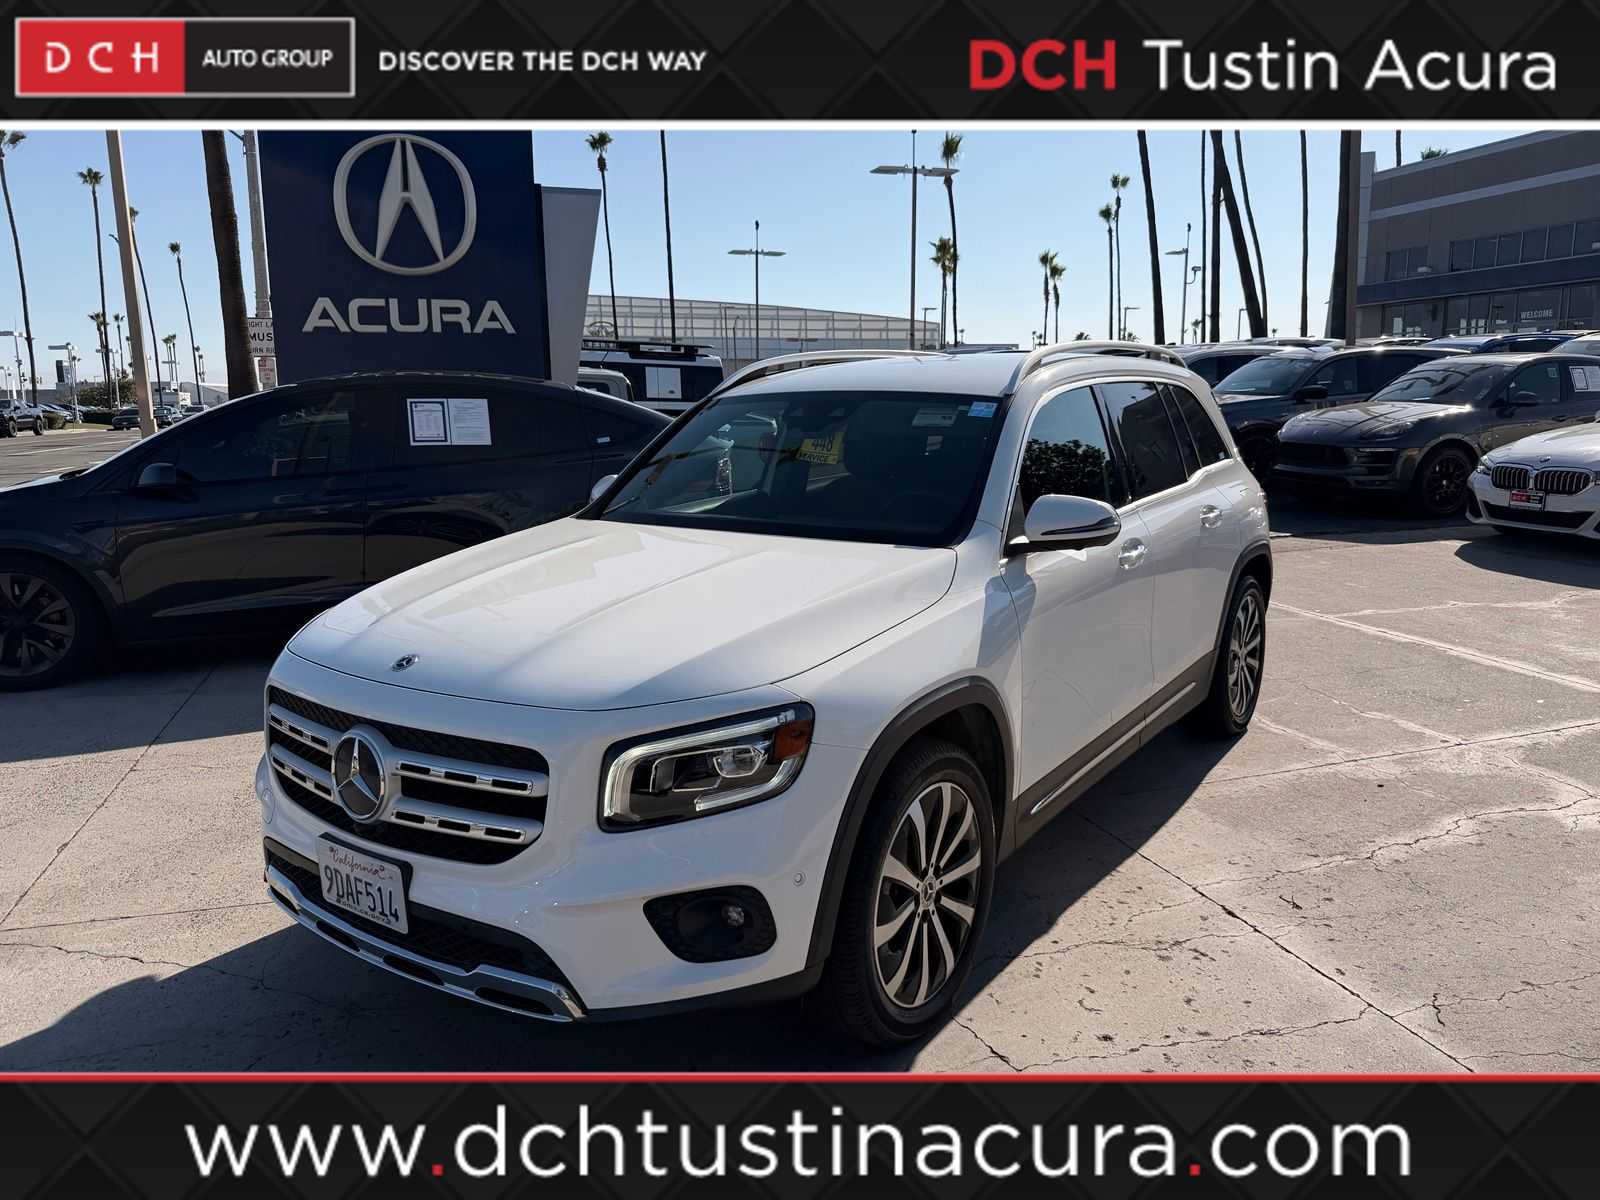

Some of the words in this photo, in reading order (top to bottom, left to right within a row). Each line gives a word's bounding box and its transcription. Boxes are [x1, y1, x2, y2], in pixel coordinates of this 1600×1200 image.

[302, 297, 516, 335] ACURA
[1520, 308, 1553, 319] WELCOME
[331, 848, 385, 877] California
[324, 864, 400, 922] 9DAF514
